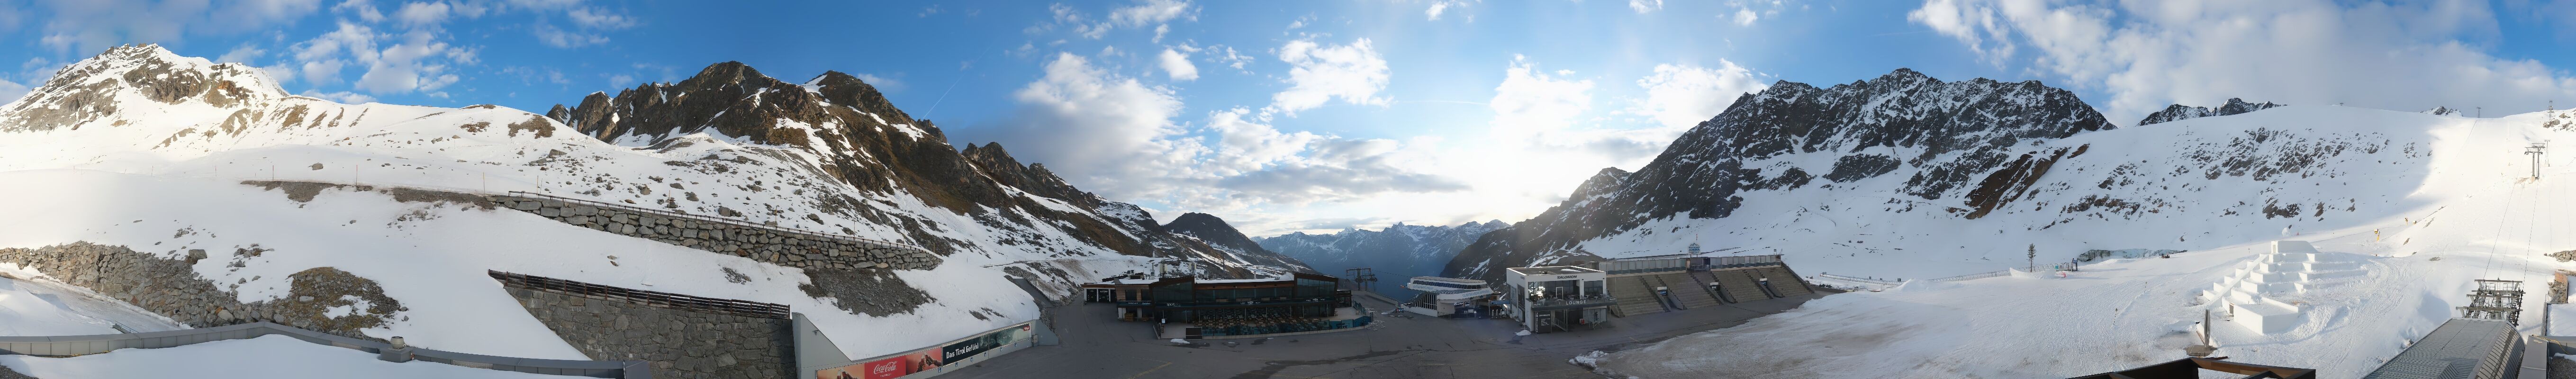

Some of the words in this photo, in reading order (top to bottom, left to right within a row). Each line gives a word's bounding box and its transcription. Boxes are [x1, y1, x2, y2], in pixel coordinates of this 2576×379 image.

[955, 346, 965, 356] Tirol
[966, 342, 979, 353] Gefühl
[874, 361, 898, 374] Coca-Cola
